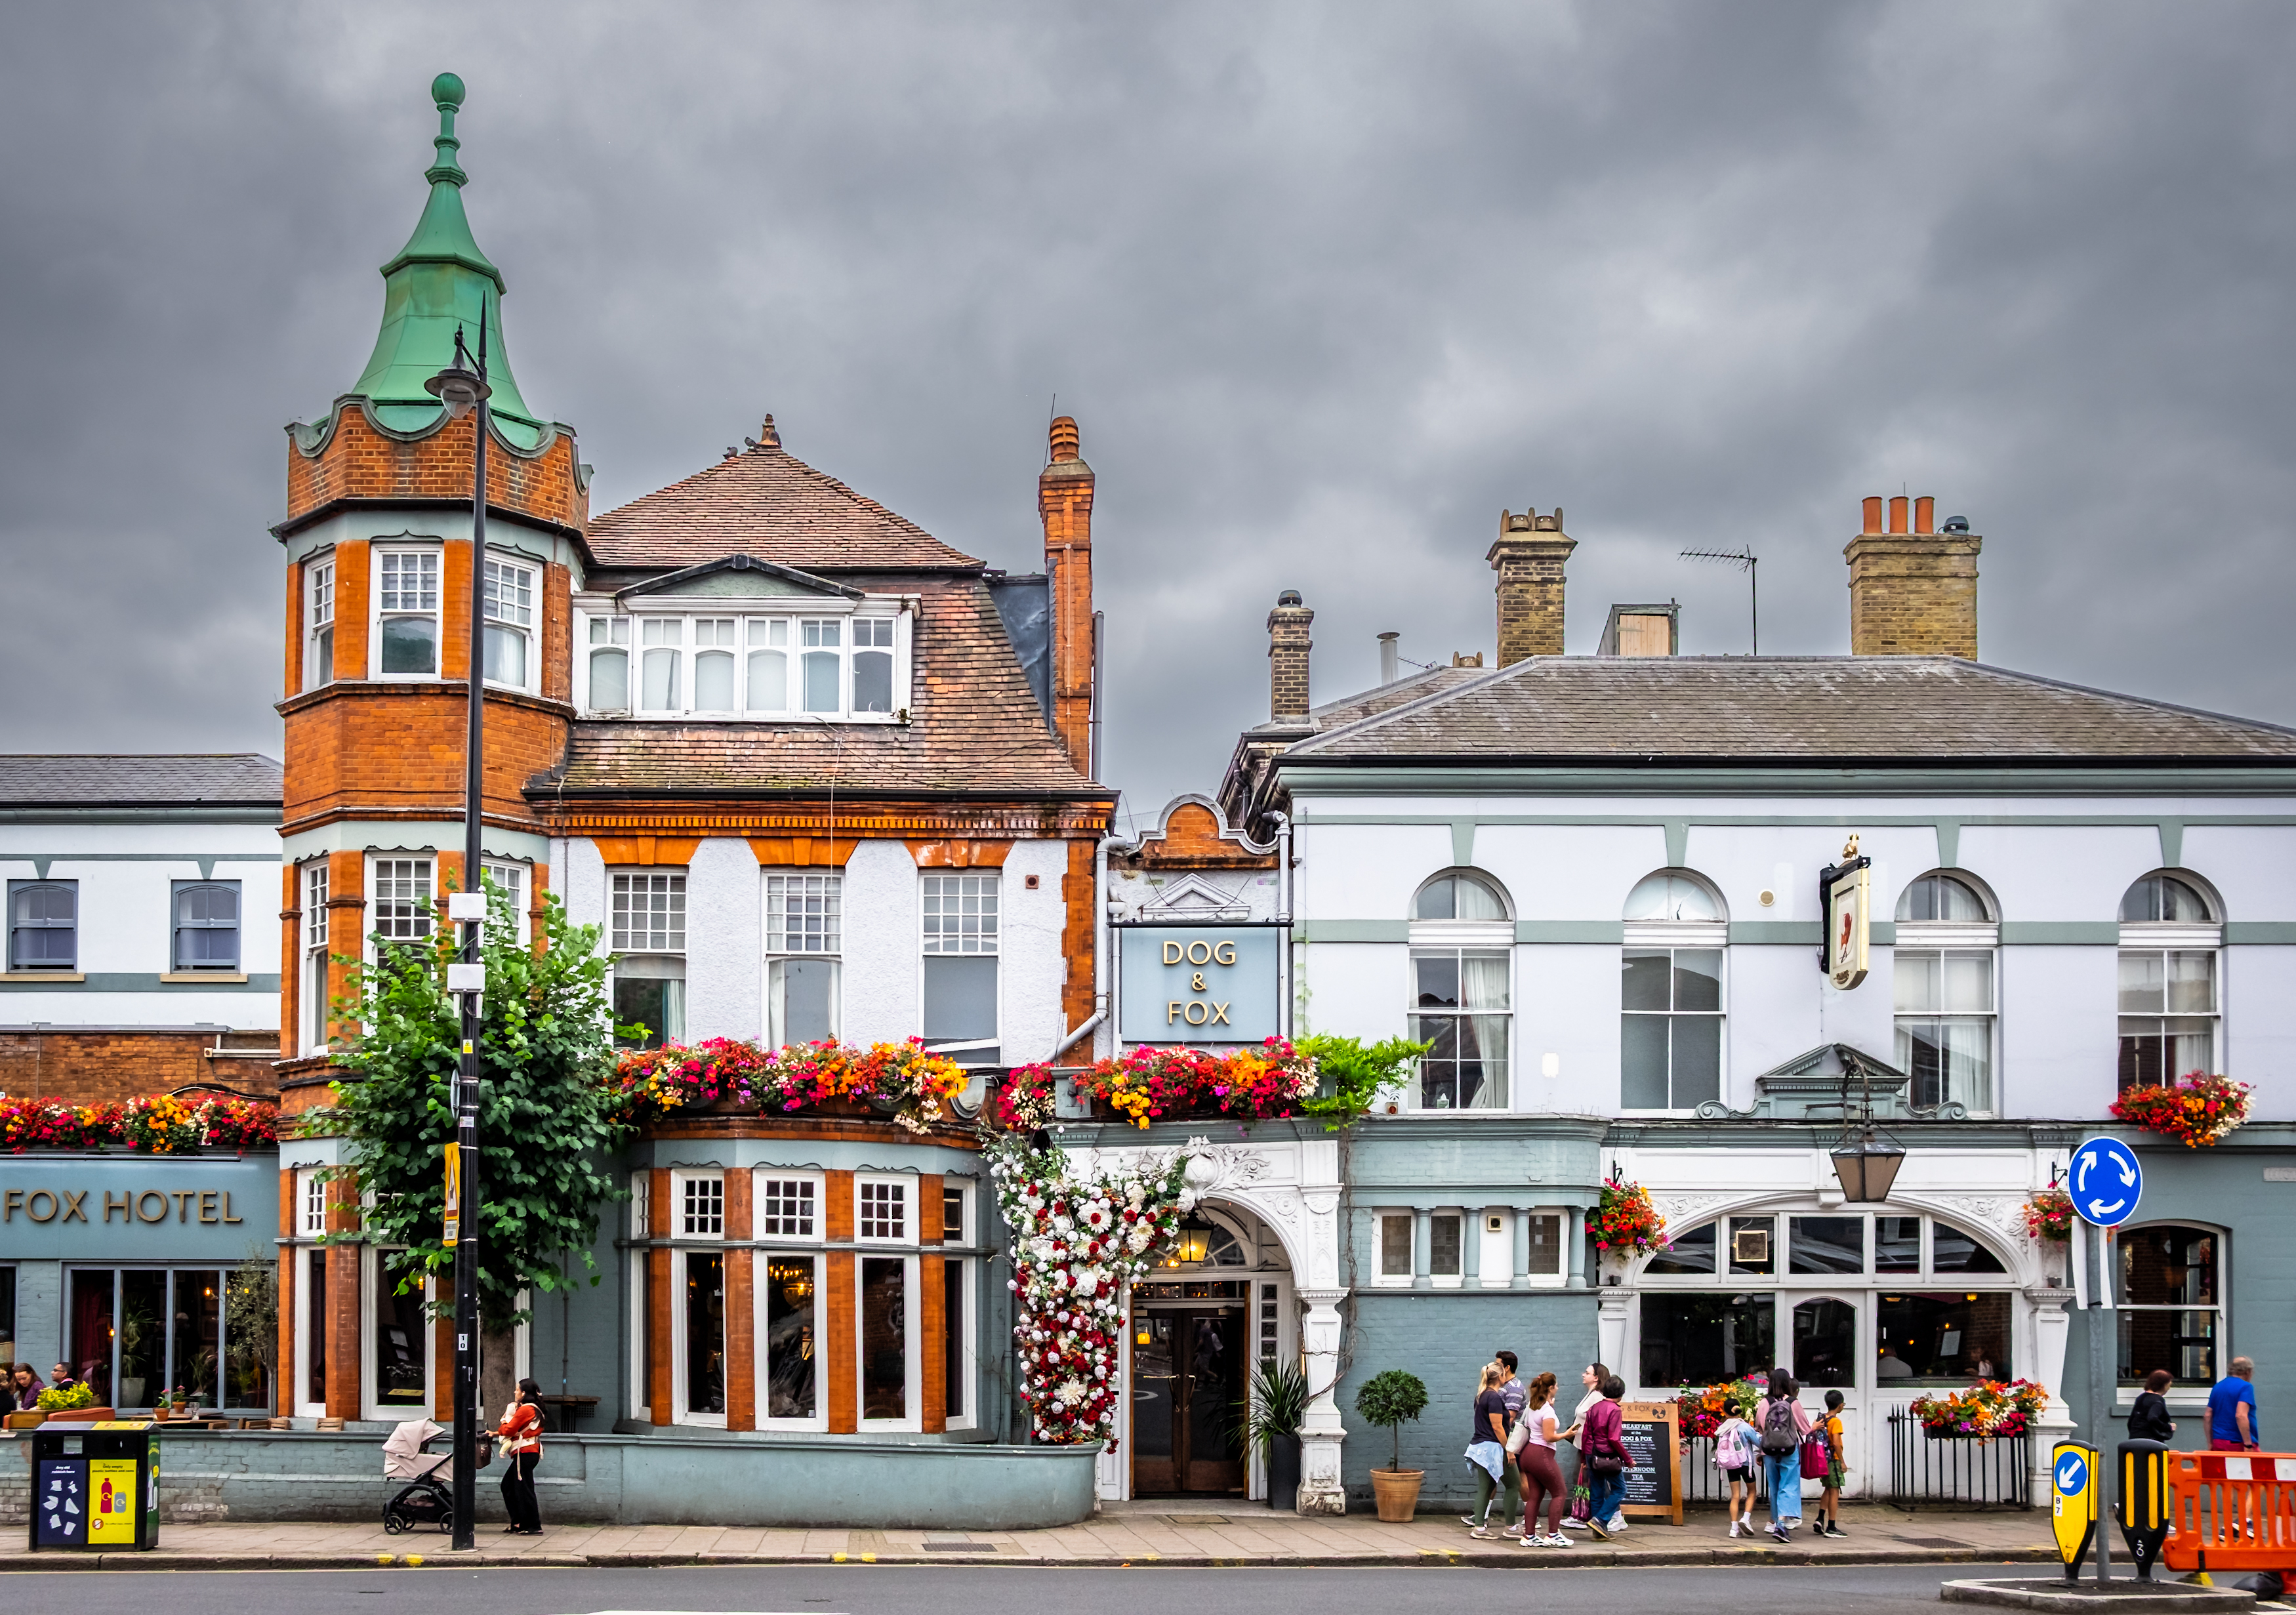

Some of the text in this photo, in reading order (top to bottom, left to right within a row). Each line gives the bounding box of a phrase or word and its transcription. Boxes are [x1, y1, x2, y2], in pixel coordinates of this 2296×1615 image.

[1162, 939, 1236, 965] DOG
[1191, 971, 1206, 991] &
[1168, 1000, 1231, 1025] FOX
[4, 1189, 243, 1223] FOX HOTEL
